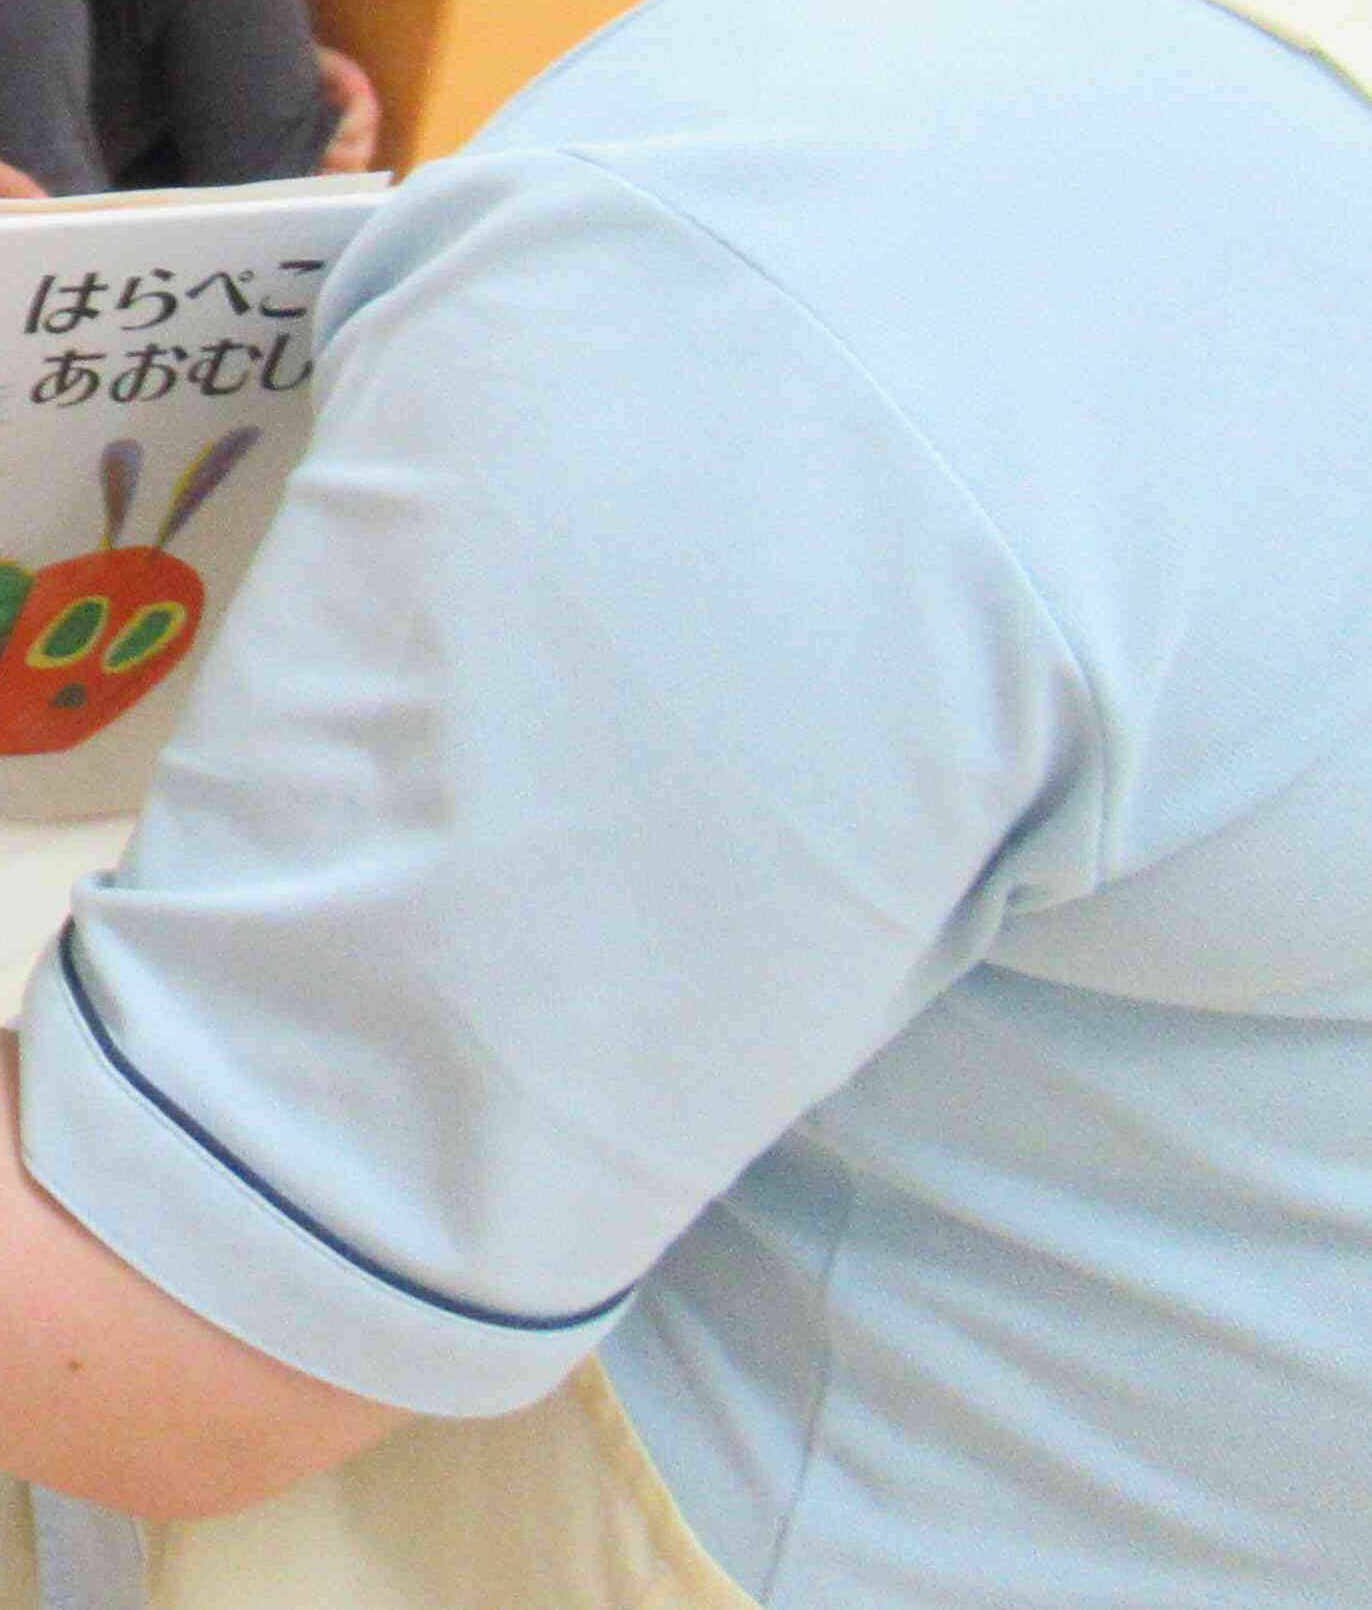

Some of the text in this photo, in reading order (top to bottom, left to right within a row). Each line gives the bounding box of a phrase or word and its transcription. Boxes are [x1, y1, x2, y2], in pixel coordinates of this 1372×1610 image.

[23, 259, 325, 335] はらぺこ
[29, 332, 313, 407] あおむし
